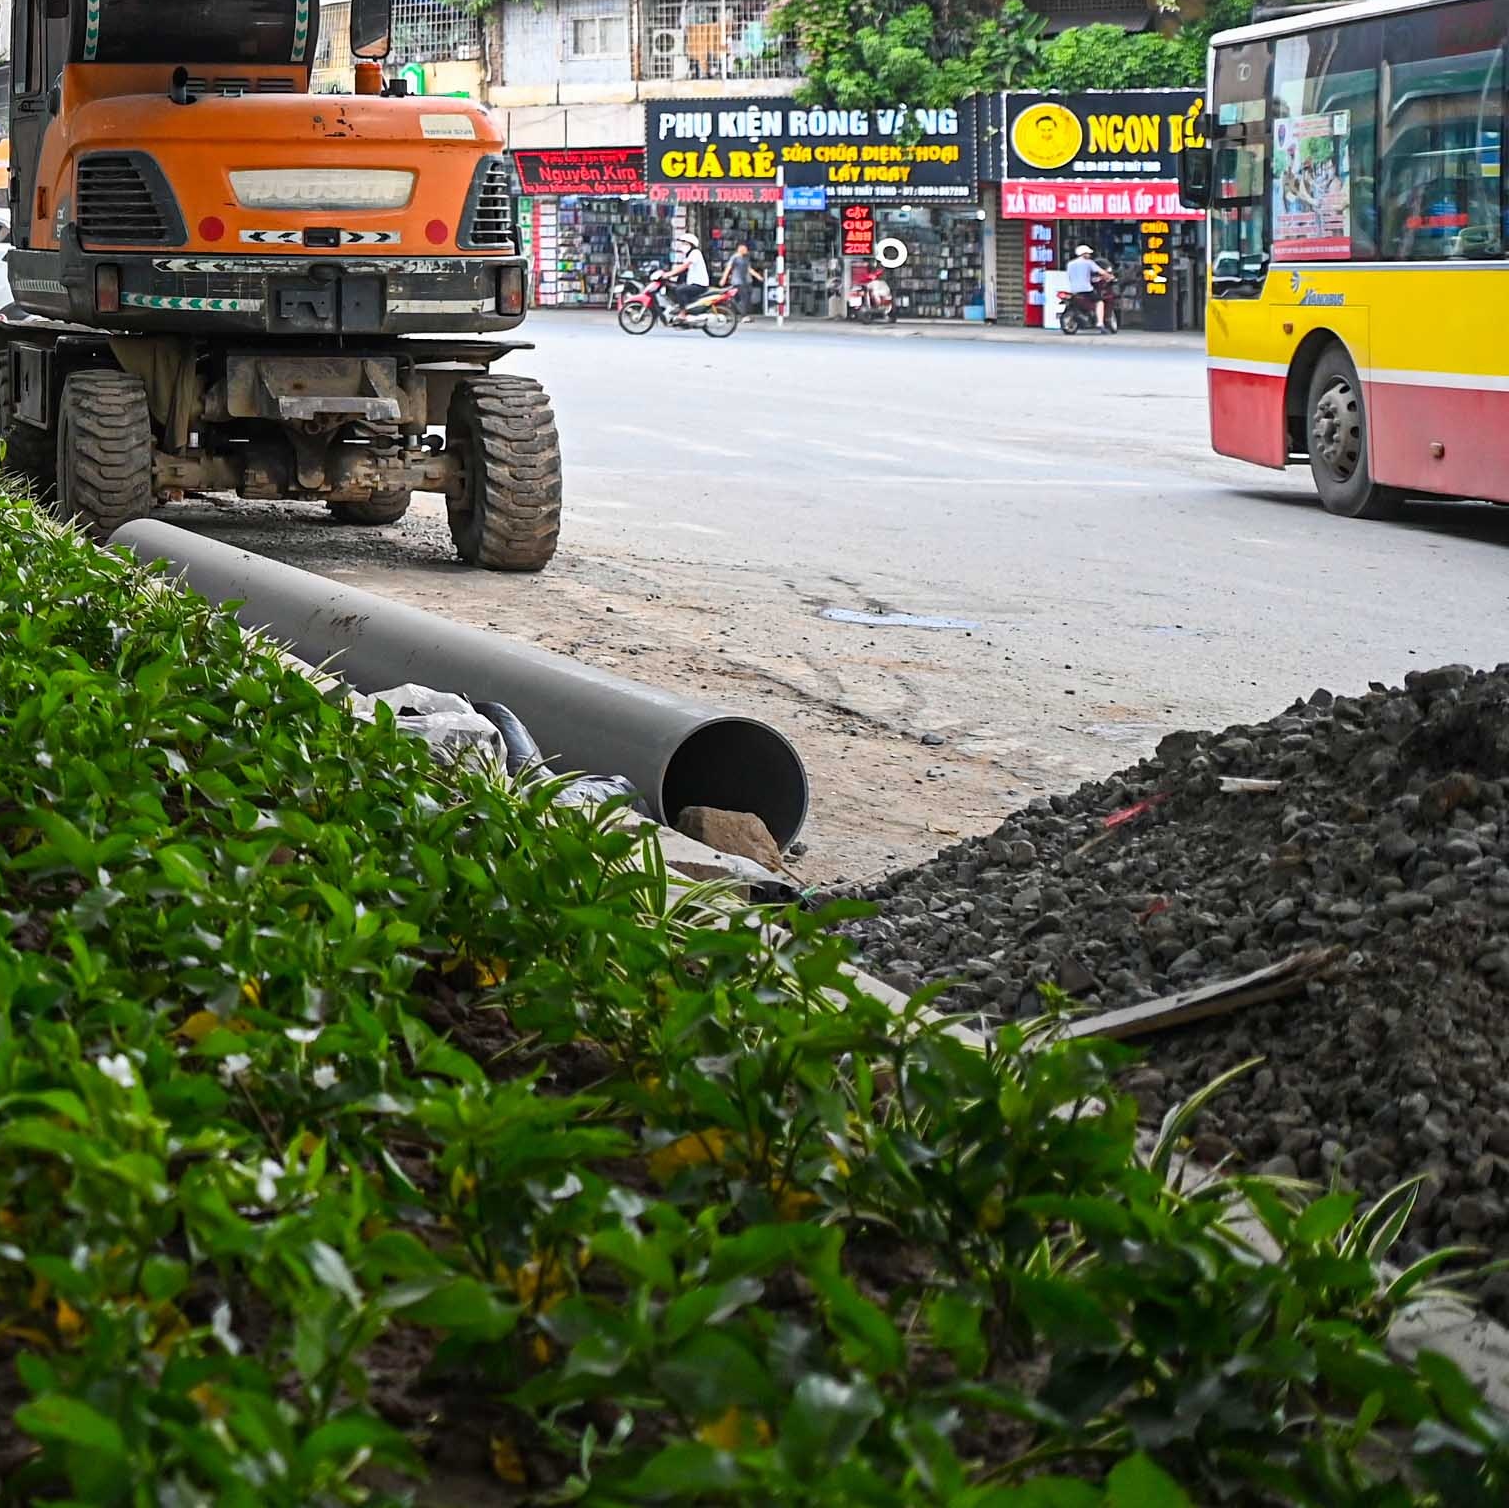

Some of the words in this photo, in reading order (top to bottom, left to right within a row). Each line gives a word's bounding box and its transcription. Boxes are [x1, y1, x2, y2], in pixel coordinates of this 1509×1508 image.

[659, 112, 712, 143] PHỤ
[718, 105, 783, 143] KIỆN
[1087, 114, 1161, 154] NGON
[539, 164, 601, 184] Nguyễn
[603, 166, 637, 181] Kim
[661, 143, 725, 178] GIÁ
[728, 143, 777, 178] RẺ
[863, 166, 912, 183] NGAY
[1027, 193, 1057, 214] KHO
[1068, 188, 1105, 214] GIẢM
[1107, 190, 1132, 214] GIÁ
[1134, 188, 1154, 214] ỐP
